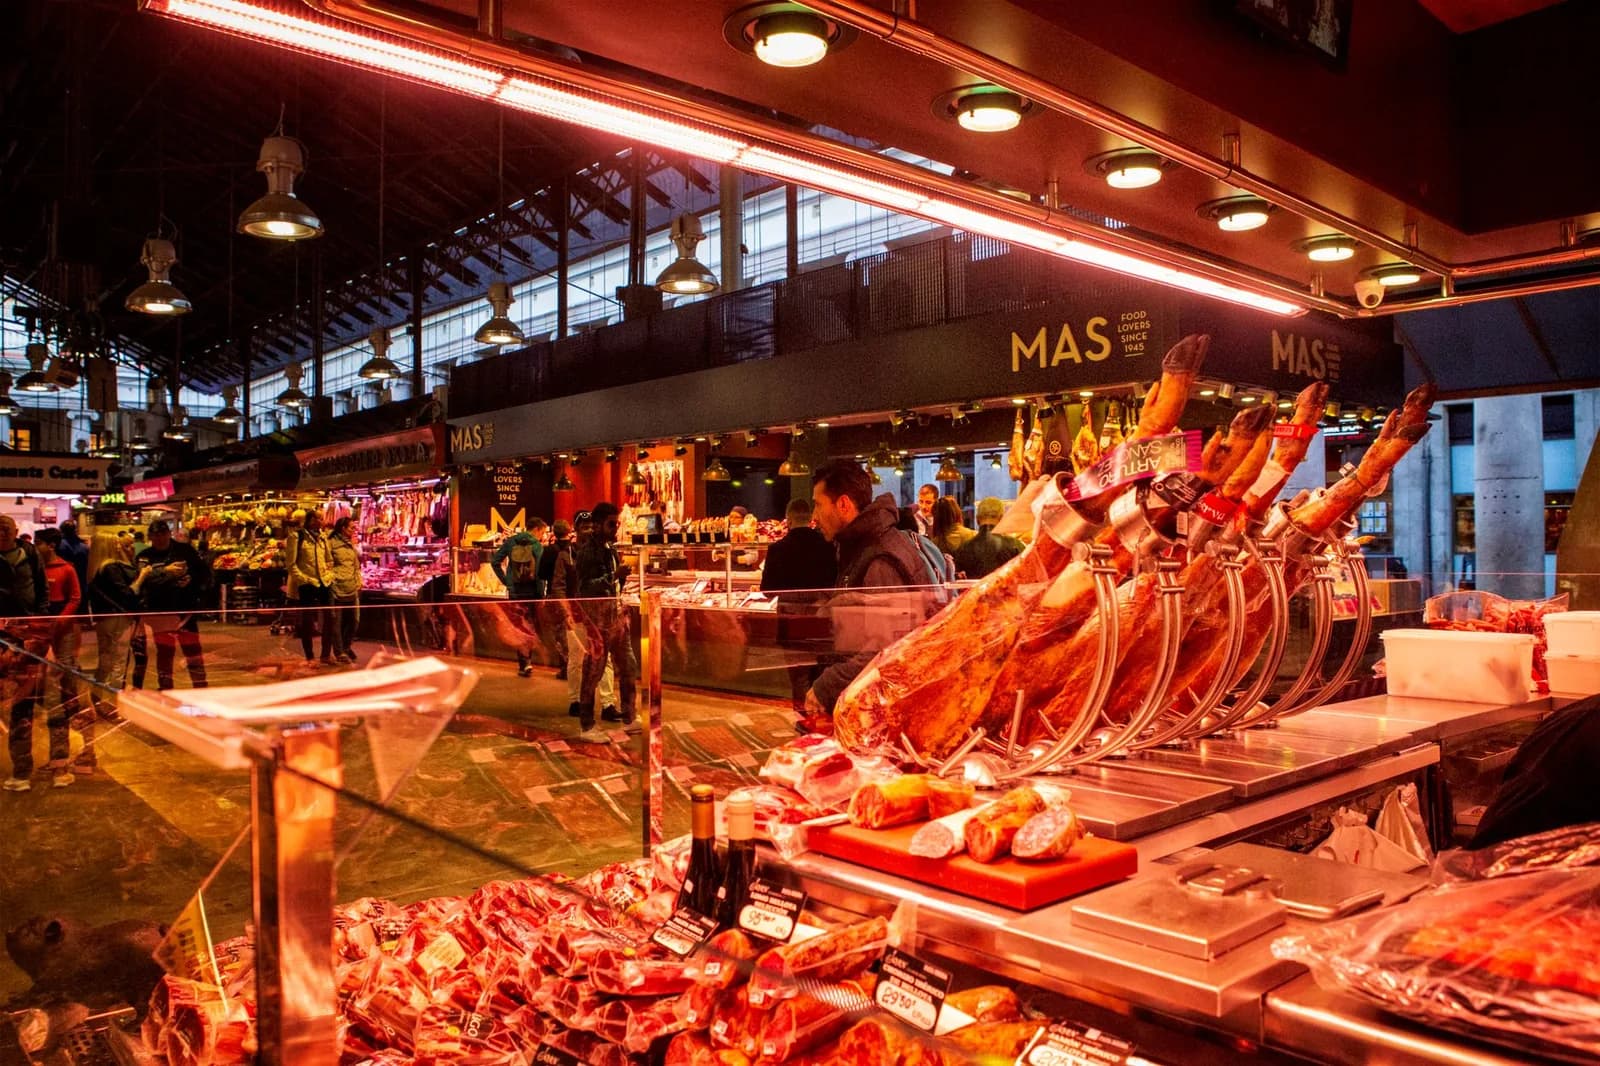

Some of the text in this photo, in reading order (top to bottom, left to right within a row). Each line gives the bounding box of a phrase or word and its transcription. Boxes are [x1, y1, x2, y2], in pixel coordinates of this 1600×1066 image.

[1121, 311, 1147, 322] FOOD
[1117, 320, 1151, 333] LOVERS
[1121, 332, 1148, 343] SINCE
[1011, 316, 1112, 372] MAS
[1124, 343, 1145, 353] 1945
[1271, 329, 1326, 379] MAS
[450, 424, 483, 453] MAS
[494, 475, 523, 484] LOVERS
[499, 493, 517, 501] 1945
